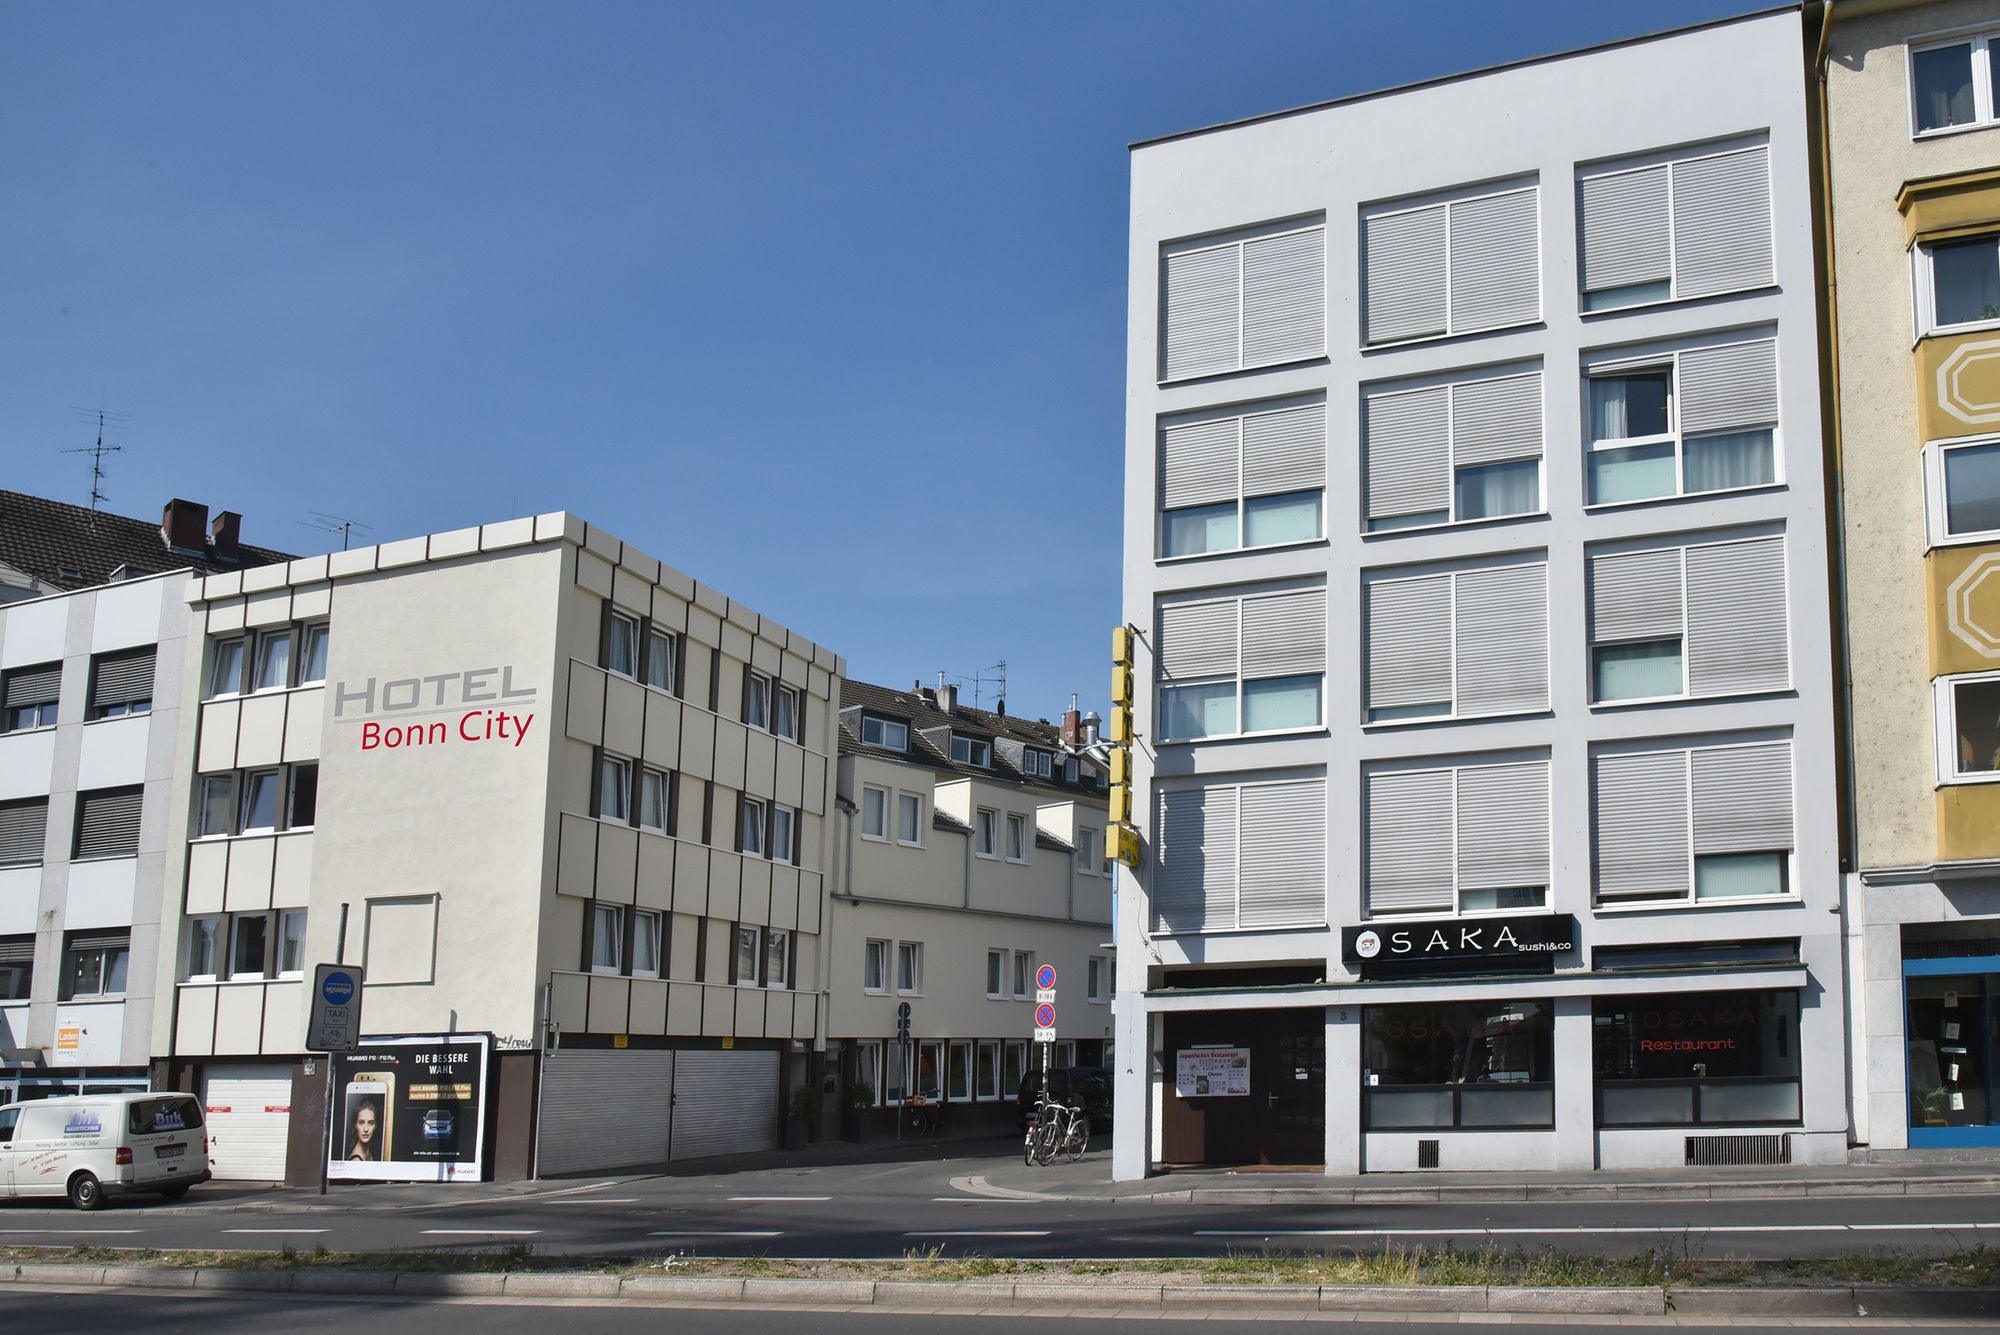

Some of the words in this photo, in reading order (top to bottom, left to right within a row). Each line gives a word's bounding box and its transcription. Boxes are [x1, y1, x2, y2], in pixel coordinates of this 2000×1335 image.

[334, 665, 537, 717] HOTEL
[361, 722, 447, 750] Bonn
[459, 709, 535, 747] City
[328, 1009, 346, 1018] TAXI
[1640, 1038, 1736, 1051] Restaurant
[415, 1054, 430, 1064] DIE
[432, 1053, 469, 1063] BESSERE
[429, 1065, 454, 1075] WAHL
[155, 1111, 181, 1124] Birk
